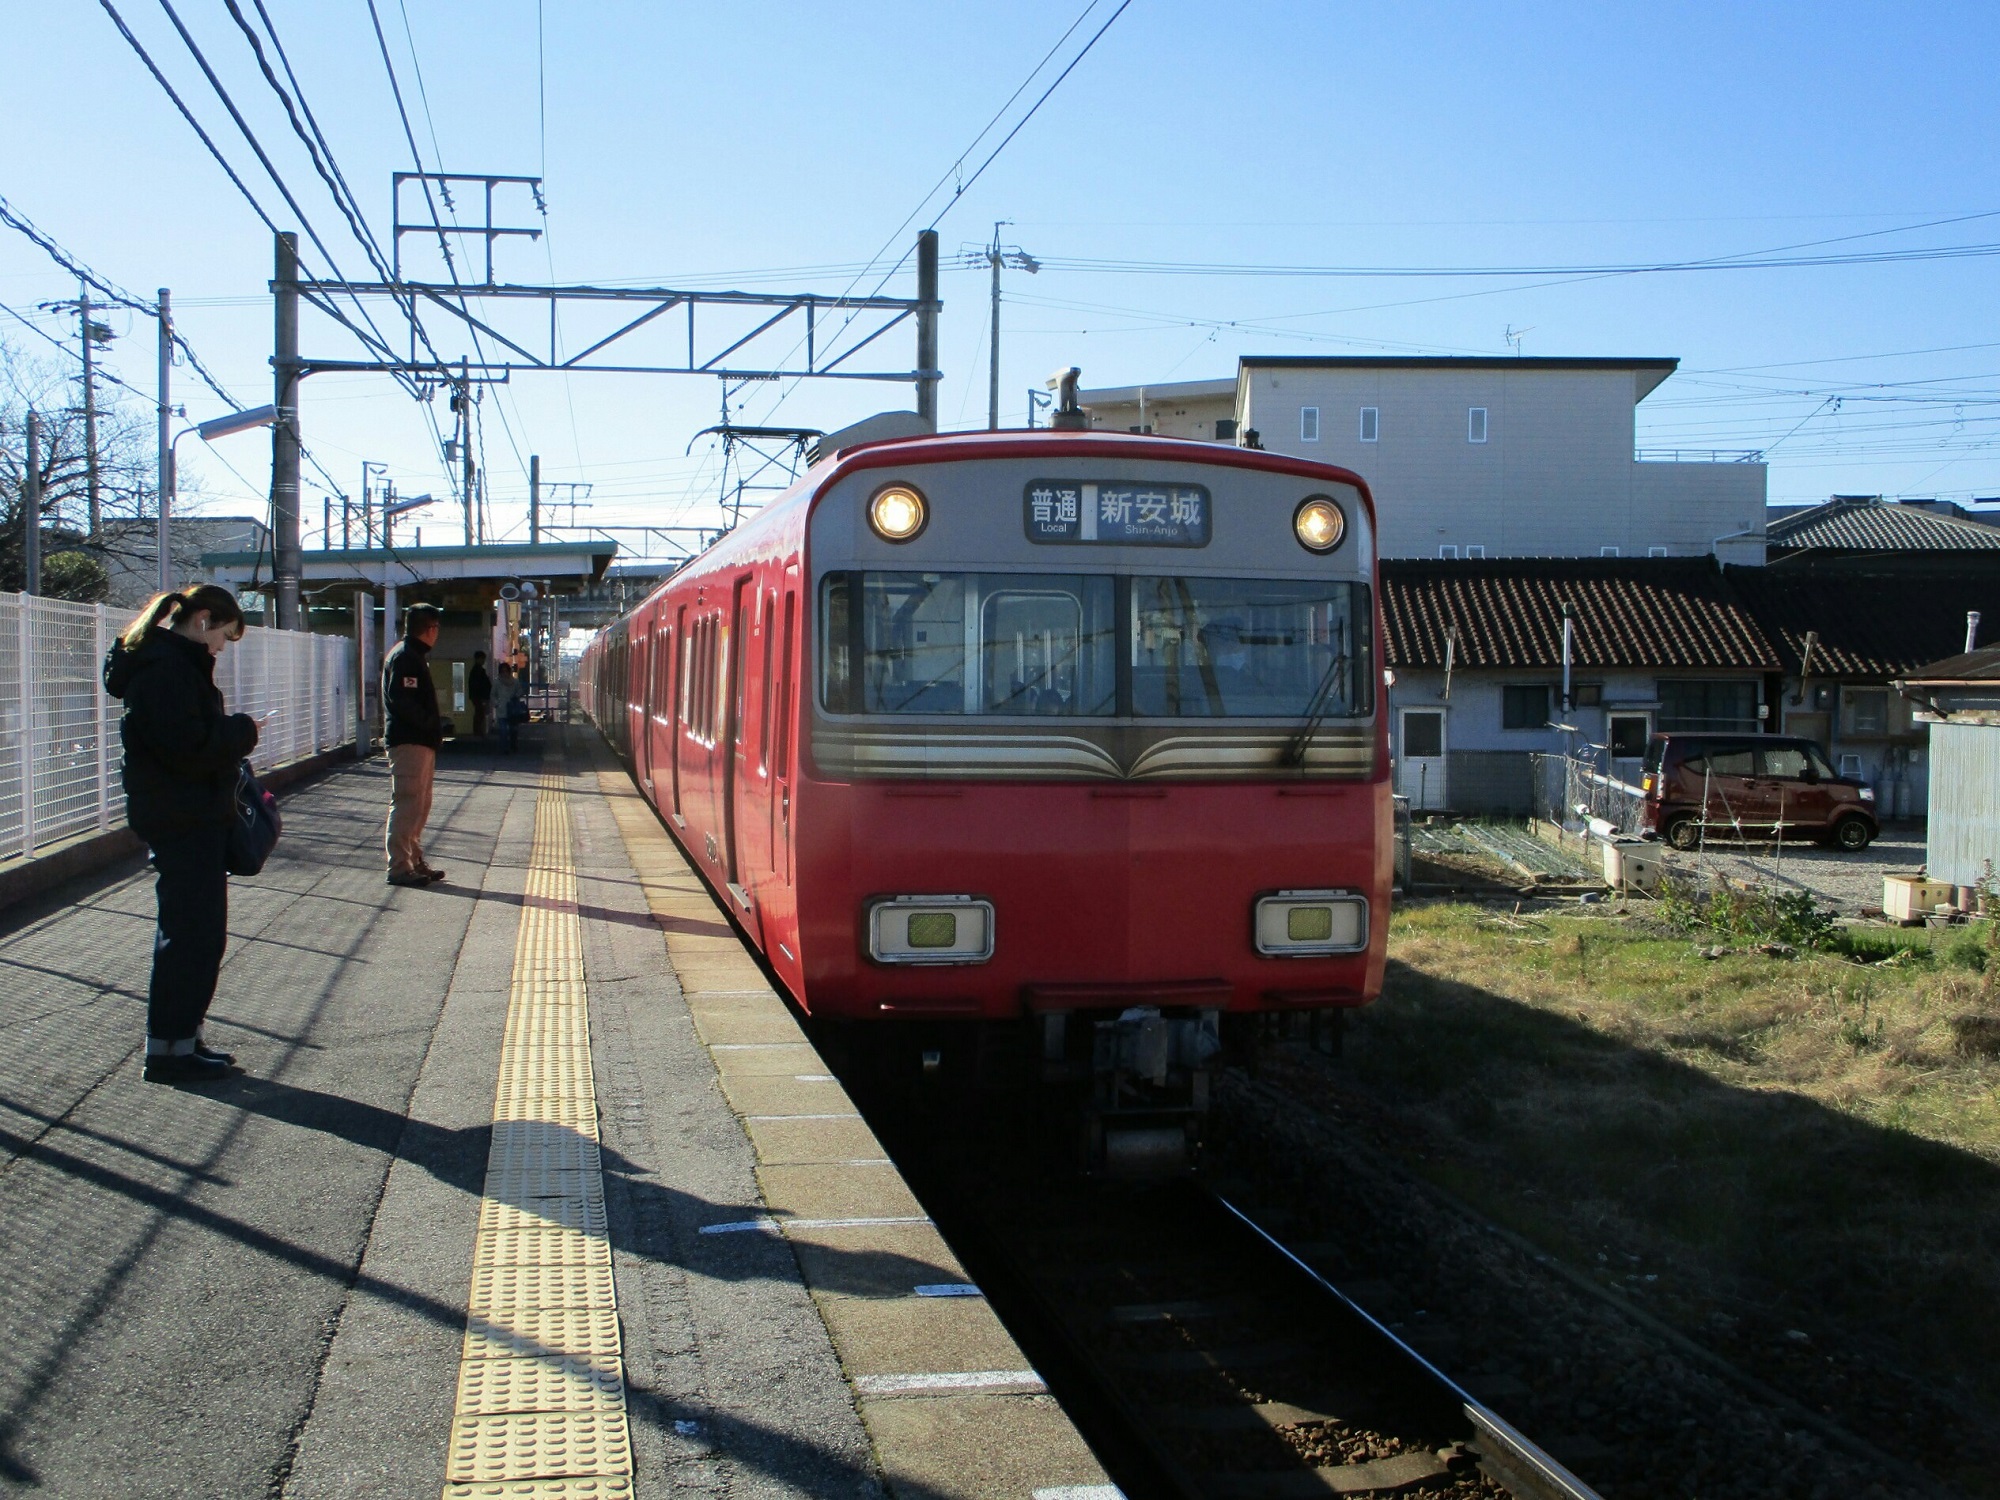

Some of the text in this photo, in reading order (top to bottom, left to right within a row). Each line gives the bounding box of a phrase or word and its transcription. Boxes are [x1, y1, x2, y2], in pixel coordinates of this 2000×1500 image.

[1031, 488, 1077, 522] 普通
[1101, 490, 1201, 525] 新安城
[1041, 522, 1067, 533] Local
